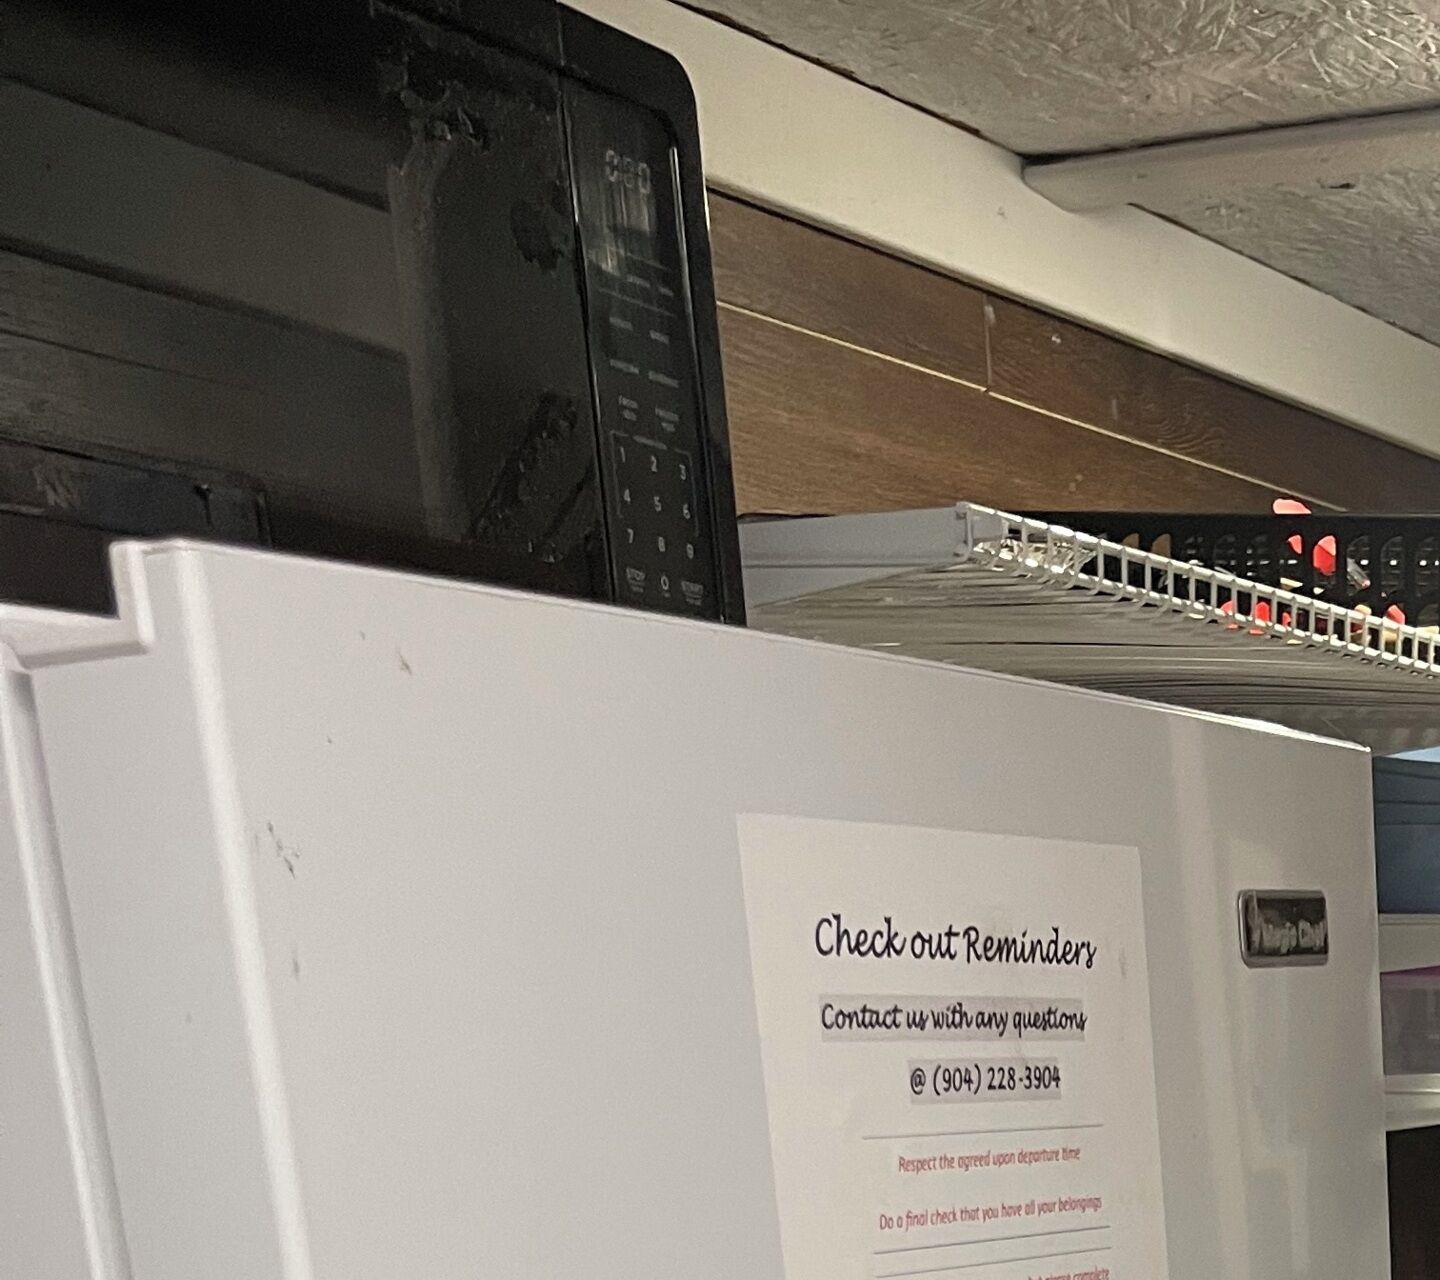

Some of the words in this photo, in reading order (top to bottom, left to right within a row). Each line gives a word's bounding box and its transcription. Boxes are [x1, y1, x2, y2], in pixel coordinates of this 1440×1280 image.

[620, 447, 626, 463] 1
[651, 455, 657, 472] 2
[679, 464, 686, 480] 3
[624, 489, 631, 503] 4
[654, 496, 661, 512] 5
[683, 504, 690, 520] 6
[627, 528, 634, 543] 7
[658, 537, 665, 552] 8
[686, 543, 694, 559] 9
[661, 575, 669, 590] 0
[815, 913, 906, 958] Check
[910, 924, 960, 960] out
[963, 925, 1097, 969] Reminders
[821, 1003, 903, 1030] Contact
[906, 1010, 928, 1031] us
[931, 1002, 973, 1030] with
[975, 1012, 1008, 1037] any
[1013, 1008, 1087, 1038] questions
[910, 1068, 926, 1095] @
[933, 1063, 981, 1096] (904)
[987, 1065, 1061, 1090] 228-3904
[898, 1156, 937, 1174] Respect
[939, 1154, 955, 1170] the
[958, 1151, 991, 1172] agreed
[992, 1153, 1016, 1168] upon
[1018, 1149, 1060, 1165] departure
[1062, 1147, 1081, 1161] time
[880, 1215, 893, 1230] Do
[896, 1218, 903, 1230] a
[905, 1210, 928, 1232] final
[930, 1207, 957, 1225] check
[960, 1207, 980, 1222] that
[982, 1209, 999, 1224] you
[1001, 1203, 1022, 1218] have
[1024, 1200, 1036, 1215] all
[1037, 1201, 1056, 1216] your
[1058, 1196, 1102, 1214] belongings
